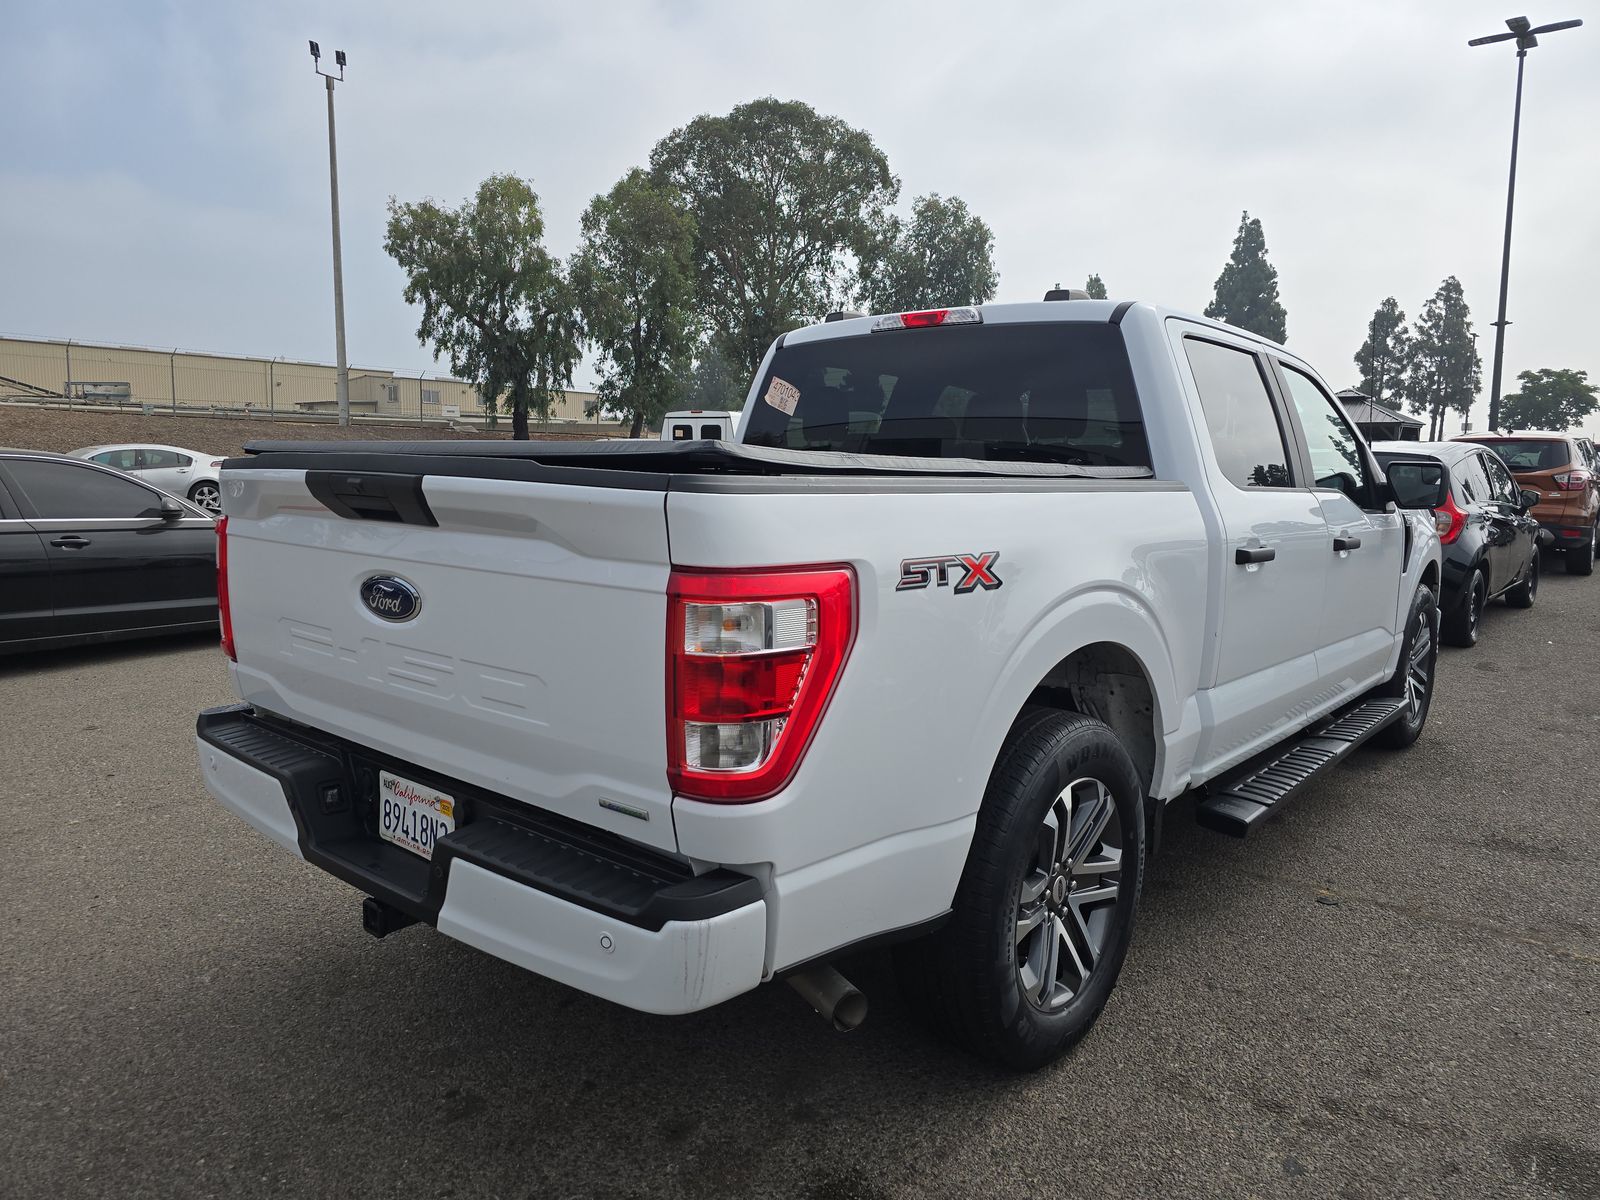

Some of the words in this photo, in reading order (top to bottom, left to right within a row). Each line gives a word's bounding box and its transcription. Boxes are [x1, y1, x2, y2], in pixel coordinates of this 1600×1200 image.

[896, 551, 1003, 595] STX
[370, 584, 403, 612] Ford
[277, 616, 550, 727] F-150
[393, 781, 436, 806] California
